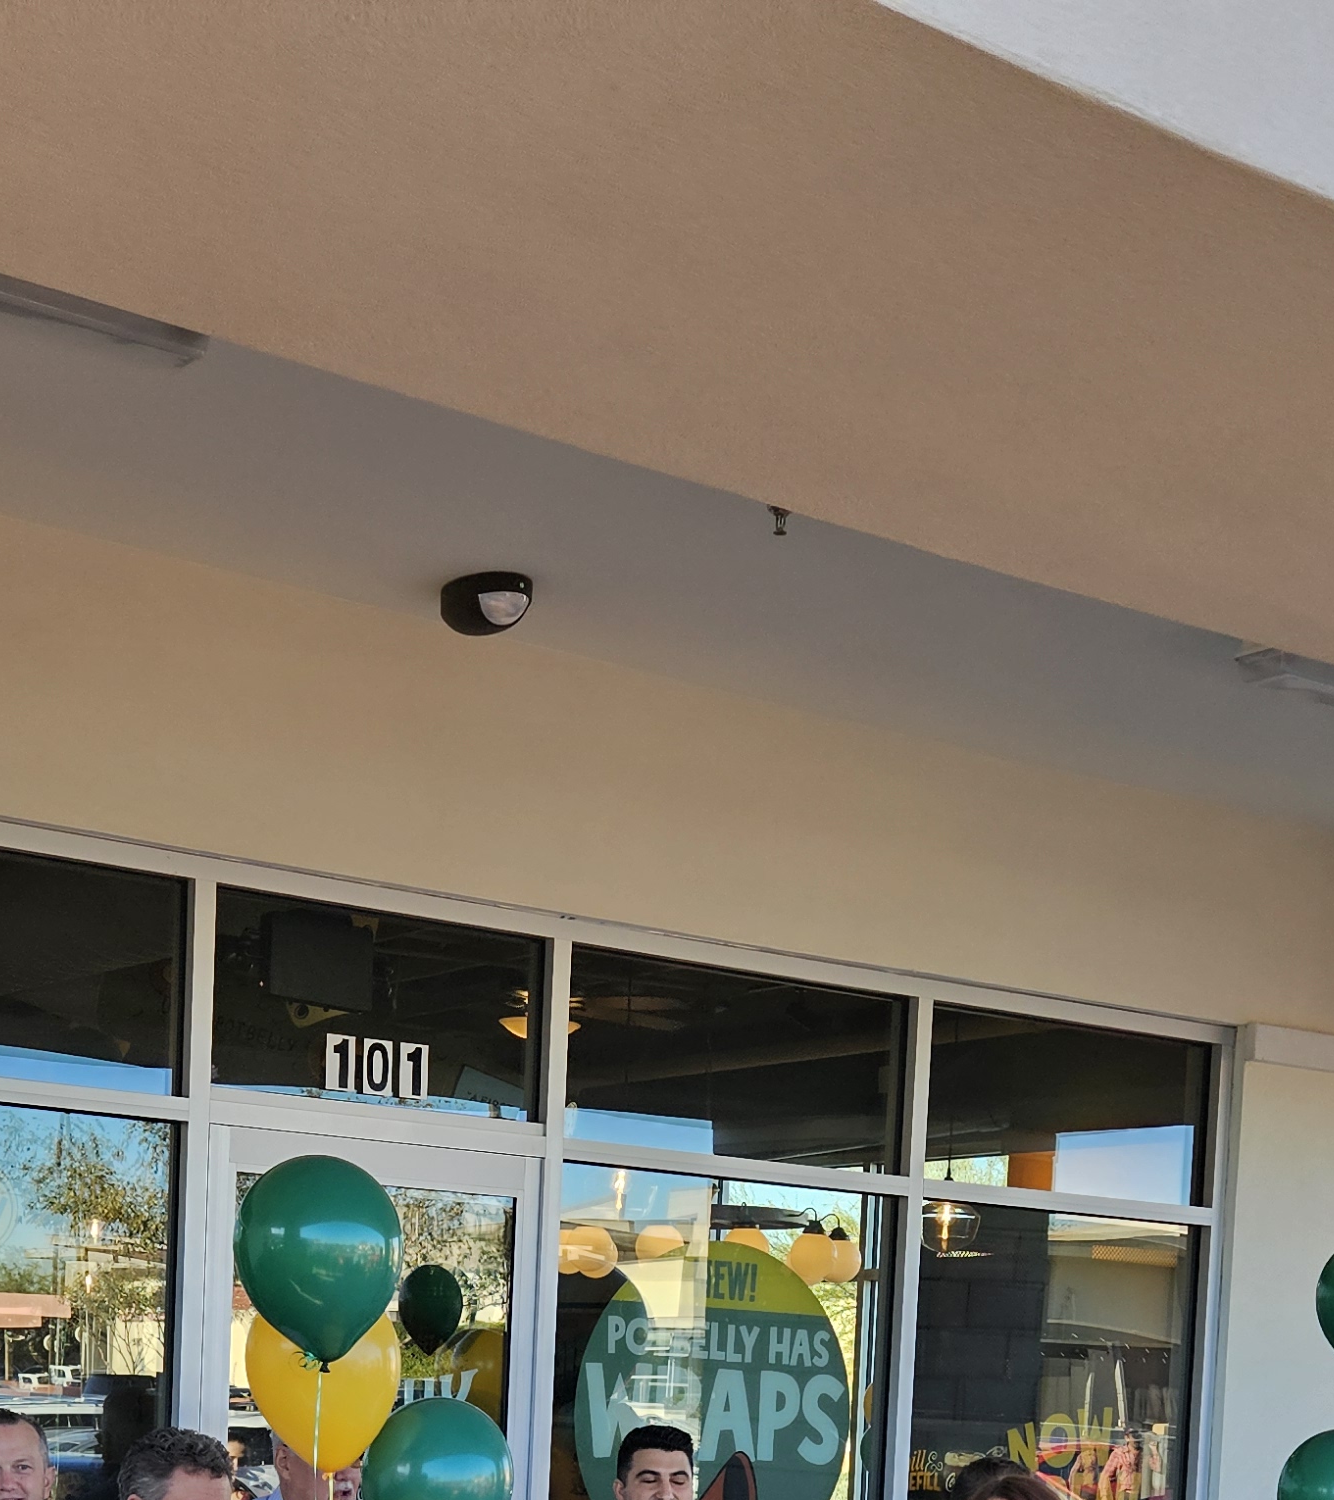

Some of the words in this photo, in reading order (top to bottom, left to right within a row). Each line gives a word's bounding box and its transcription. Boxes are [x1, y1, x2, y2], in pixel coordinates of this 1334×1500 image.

[333, 1037, 423, 1098] 101
[607, 1315, 760, 1363] POELLY
[768, 1326, 830, 1368] HAS
[585, 1362, 846, 1465] WRAPS
[1007, 1407, 1113, 1474] NOW
[909, 1472, 940, 1491] EFILL
[910, 1449, 927, 1472] ill
